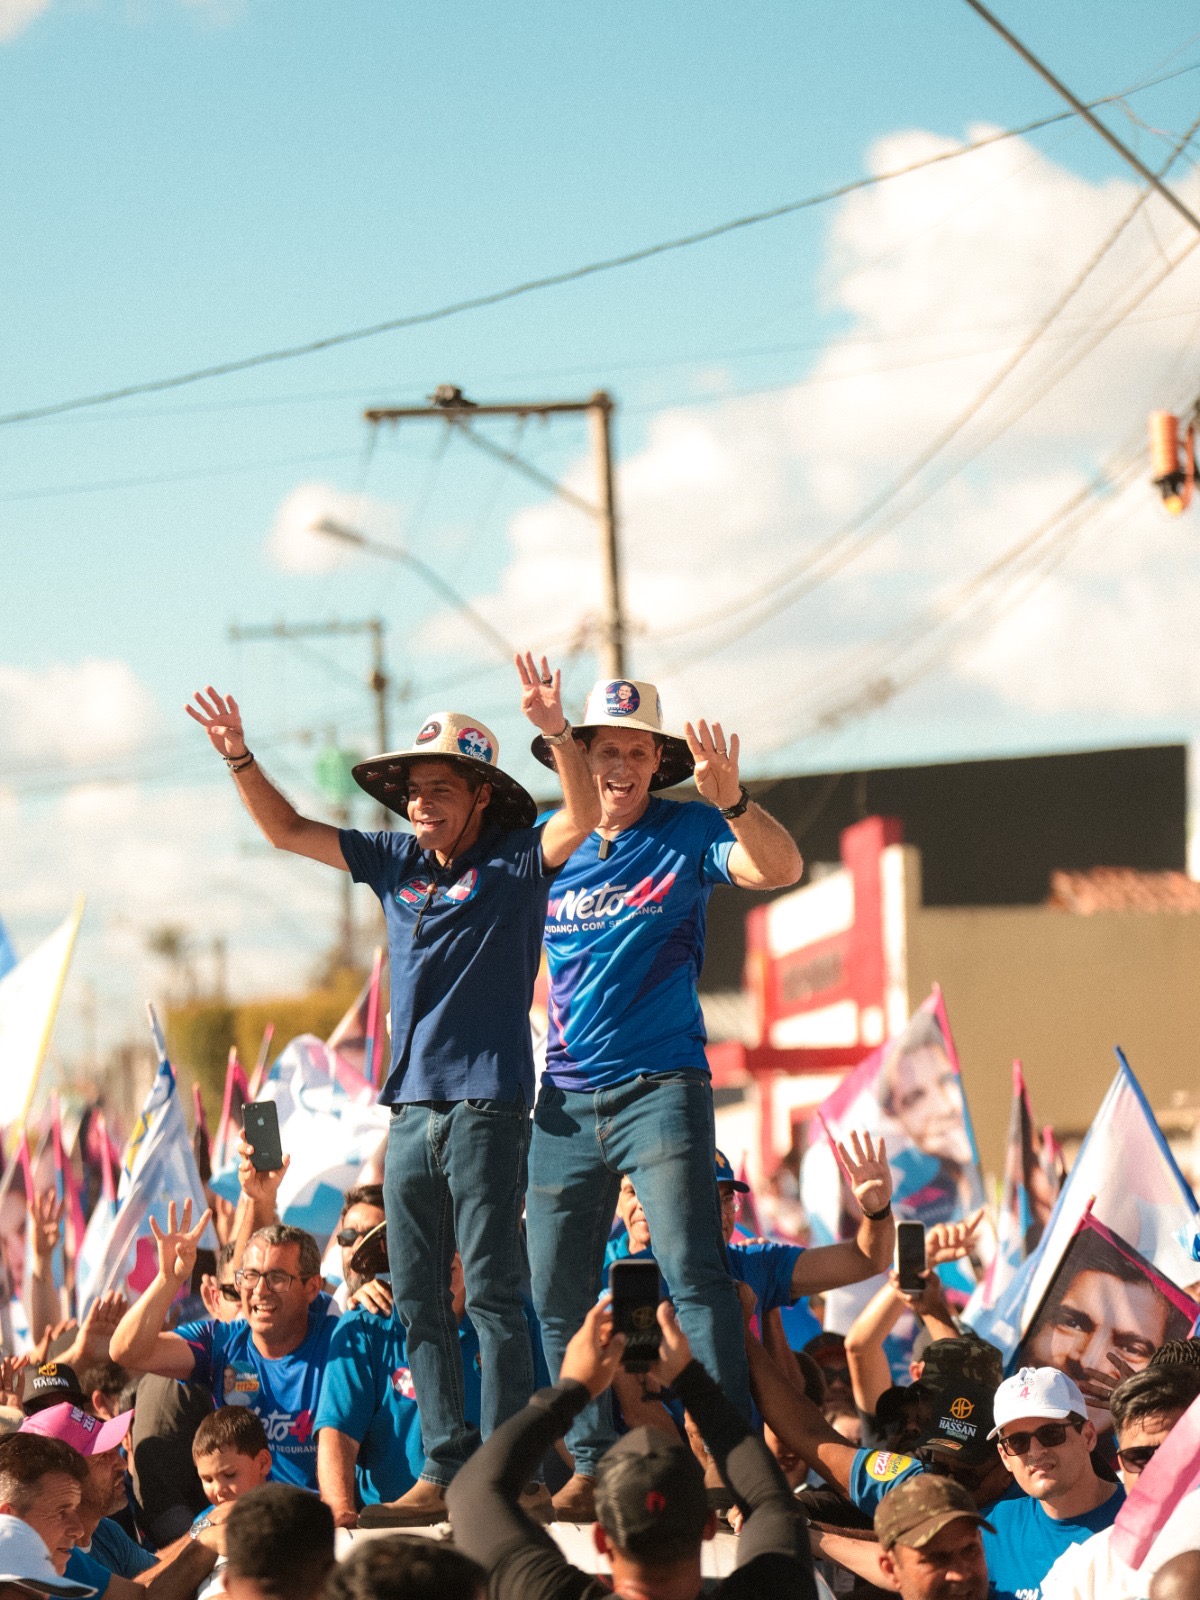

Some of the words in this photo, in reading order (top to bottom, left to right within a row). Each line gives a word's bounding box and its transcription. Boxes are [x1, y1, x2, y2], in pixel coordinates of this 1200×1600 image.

[464, 731, 488, 753] 44
[555, 882, 634, 922] Neto
[625, 872, 677, 910] 44
[582, 921, 605, 931] COM
[32, 1375, 69, 1390] HASSAN
[254, 1406, 296, 1441] eto
[939, 1419, 977, 1437] HASSAN
